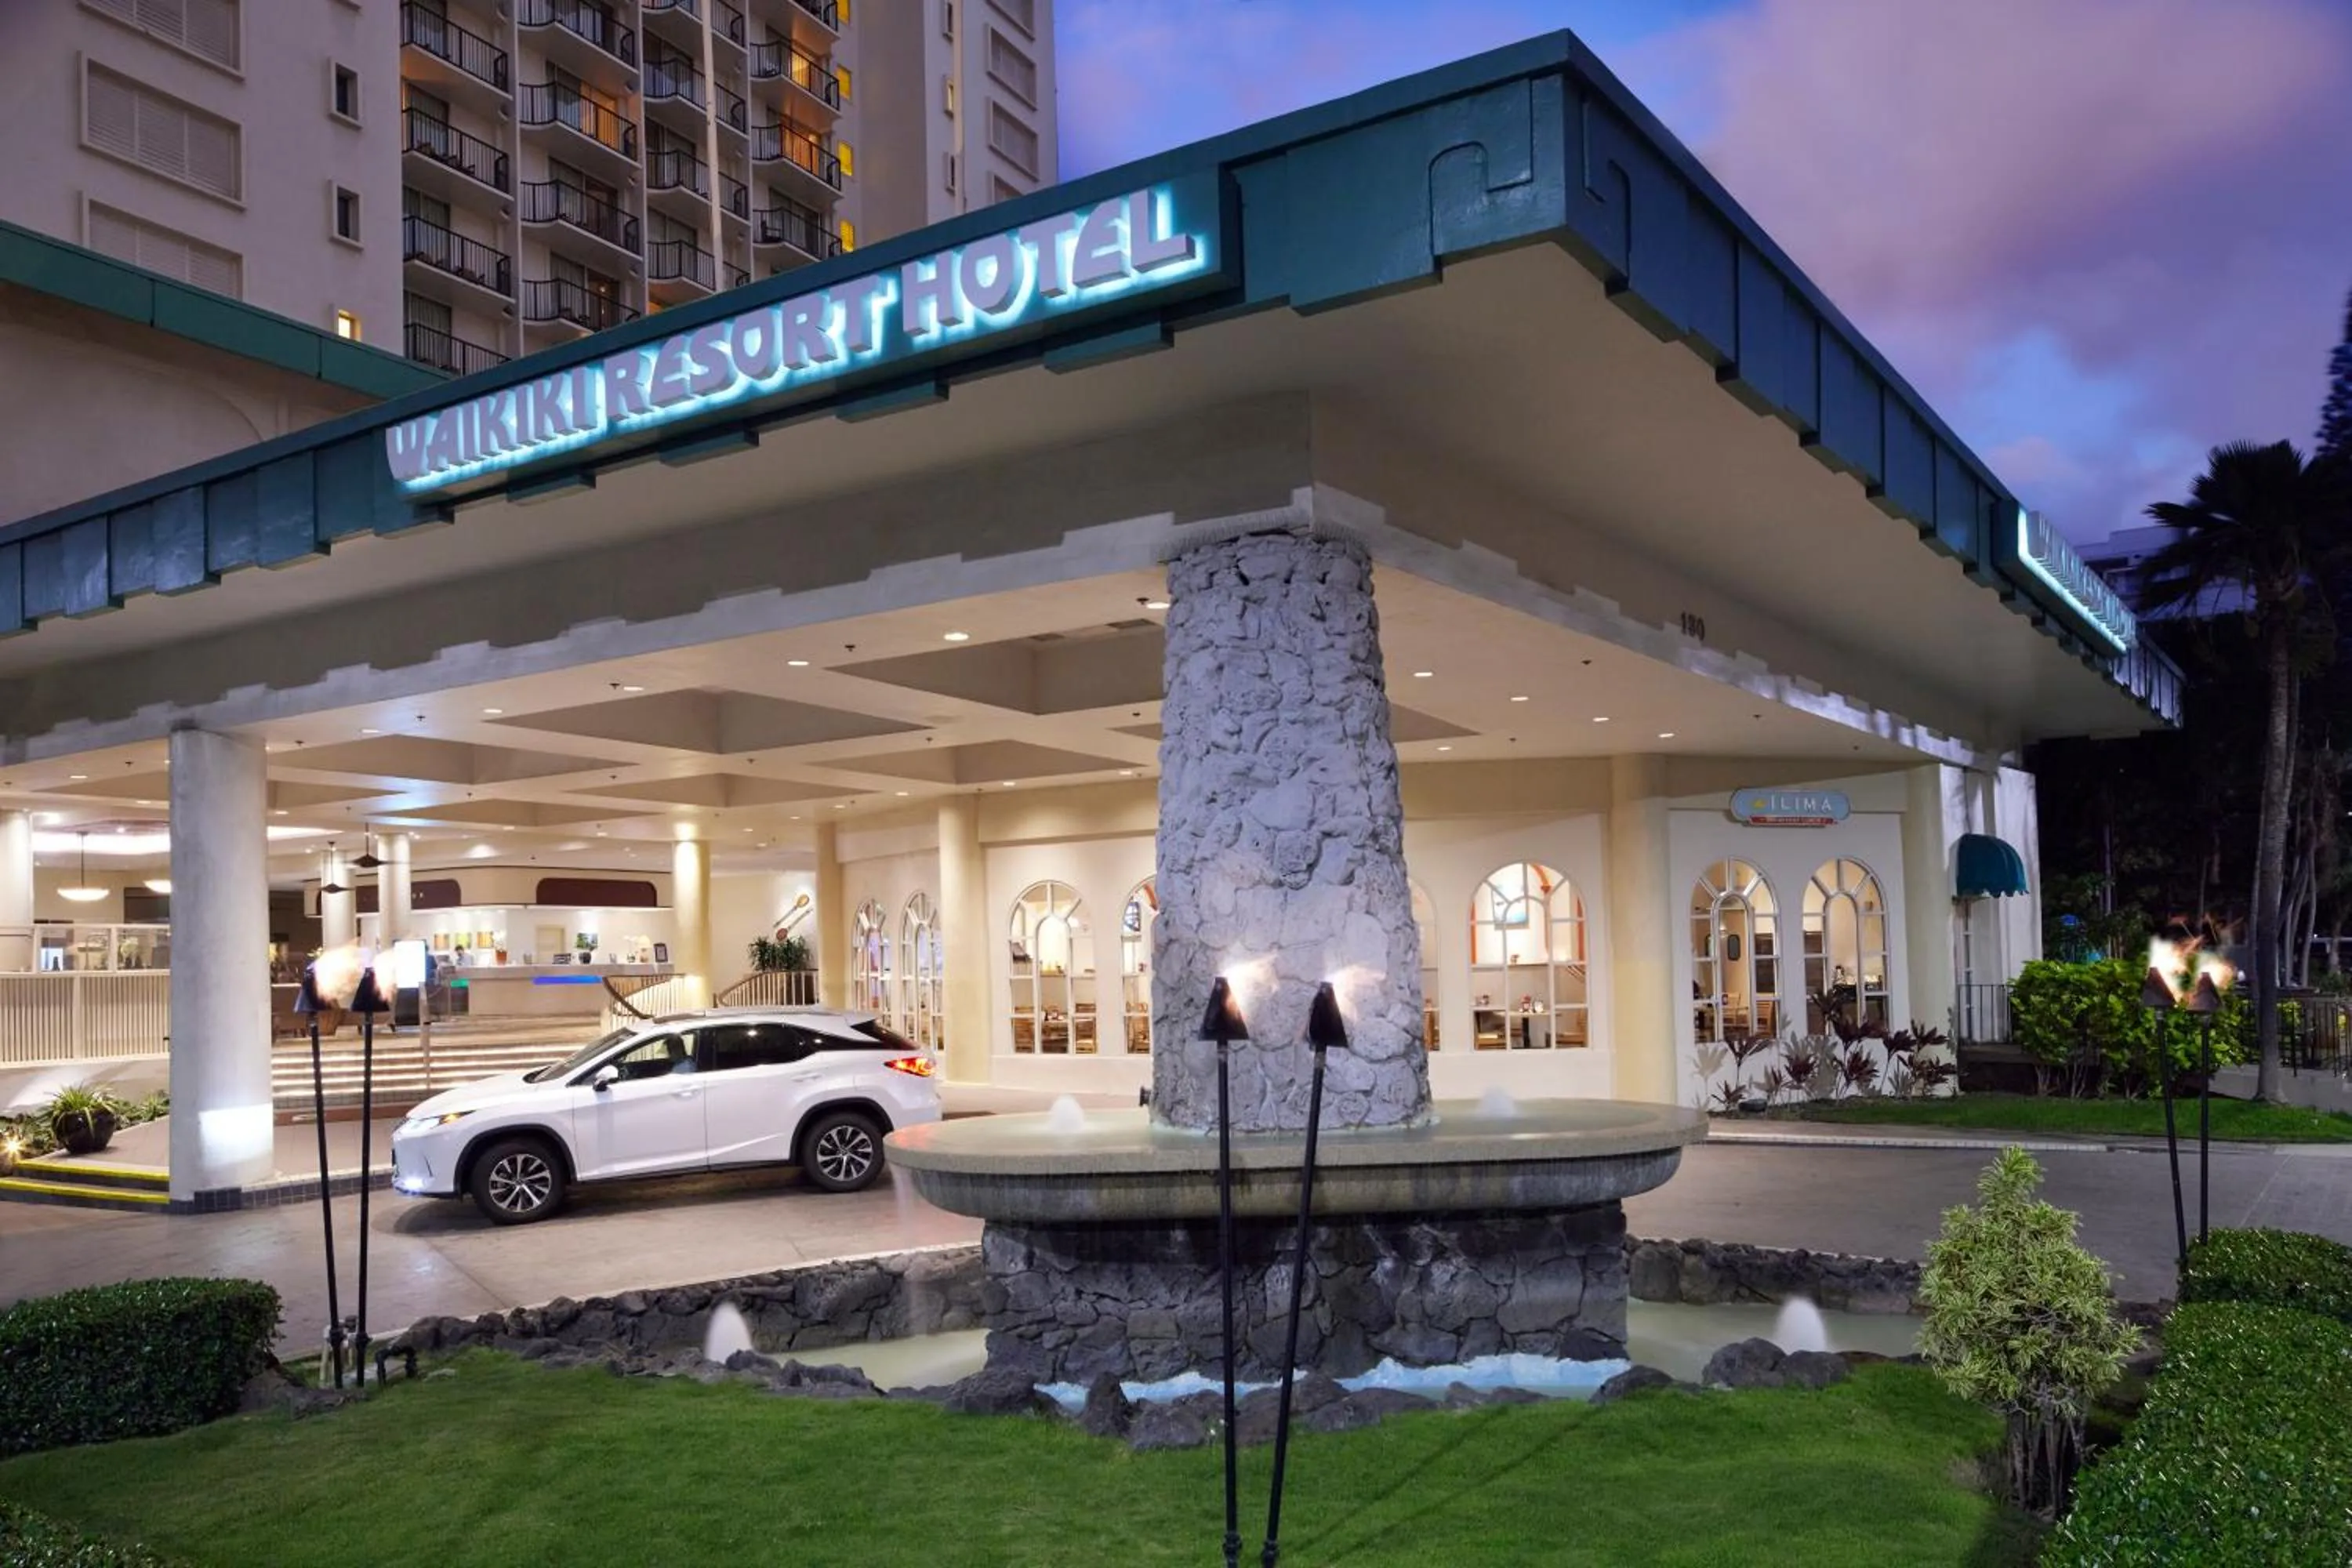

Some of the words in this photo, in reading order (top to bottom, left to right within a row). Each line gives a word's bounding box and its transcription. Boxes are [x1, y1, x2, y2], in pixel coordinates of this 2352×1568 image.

[386, 365, 600, 482] WAIKIKI
[603, 274, 891, 422] RESORT
[901, 187, 1196, 337] HOTEL
[1769, 794, 1833, 812] ILIMA
